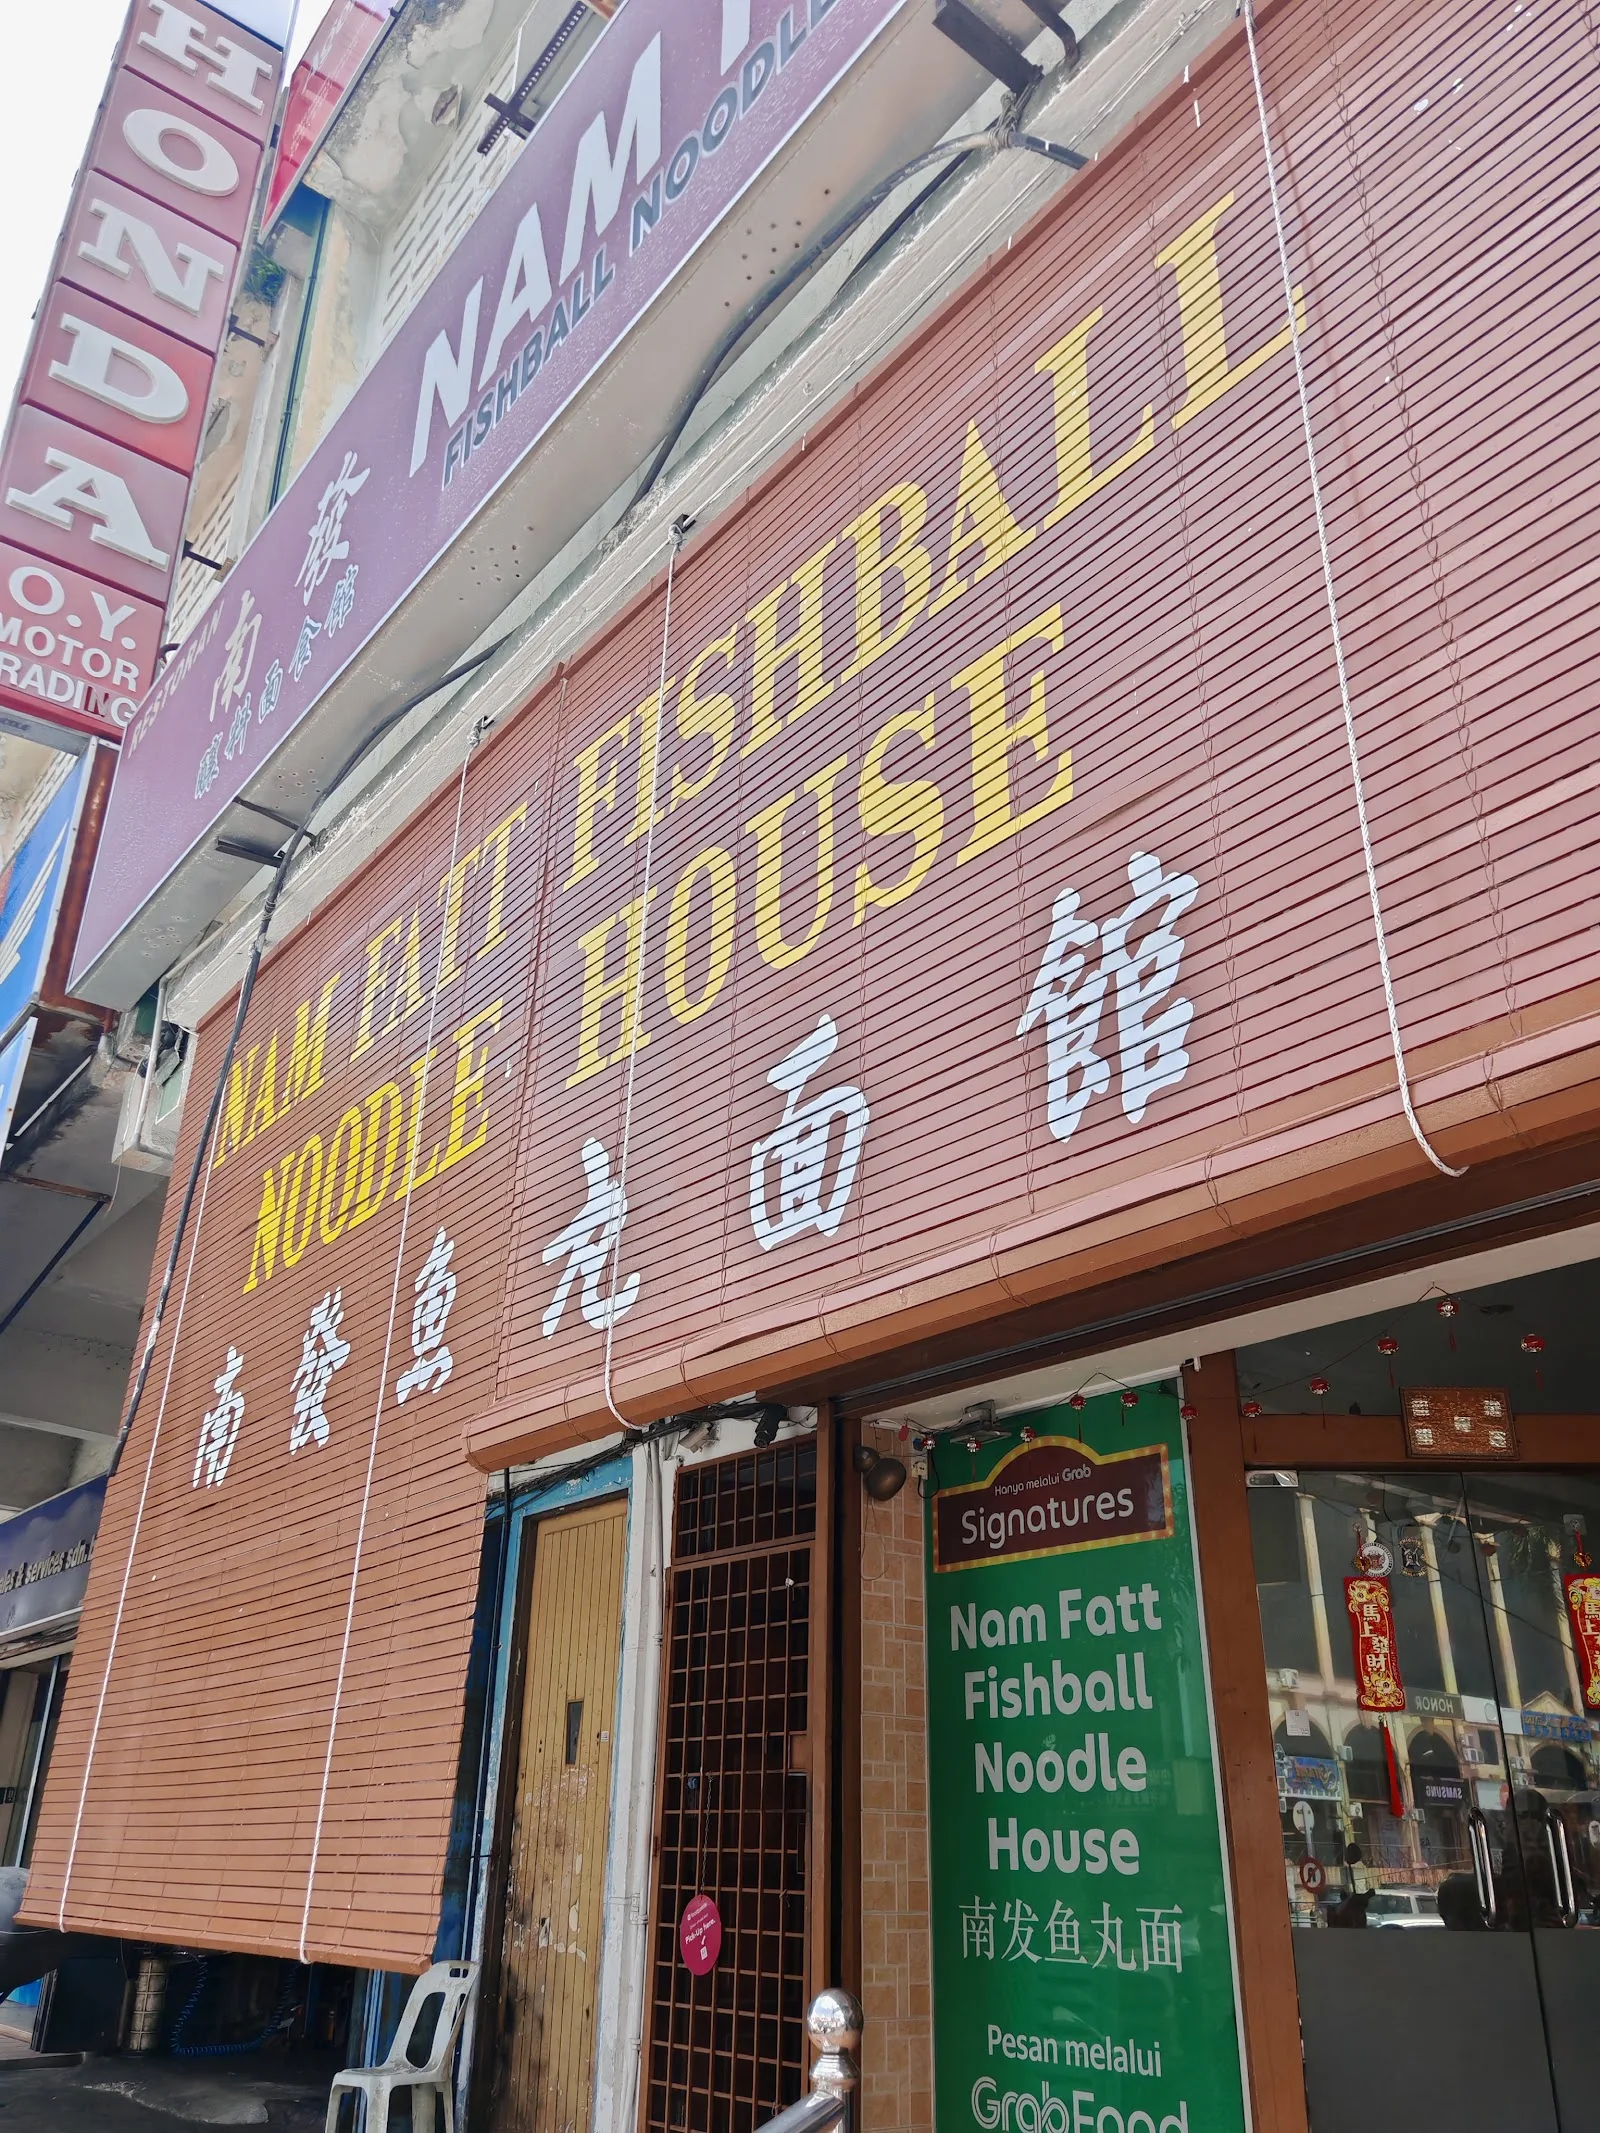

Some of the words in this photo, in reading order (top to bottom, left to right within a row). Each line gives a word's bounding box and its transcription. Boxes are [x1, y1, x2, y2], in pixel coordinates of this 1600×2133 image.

[5, 0, 274, 572] HONDA
[408, 30, 662, 479] NAM
[441, 242, 616, 492] FISHBALL
[8, 566, 137, 650] O.Y.
[127, 599, 225, 760] RESTORAN
[212, 971, 342, 1169] NAM
[348, 802, 530, 1063] FATT
[563, 191, 1306, 892] FISHBALL
[241, 998, 503, 1295] NOODLE
[565, 603, 1074, 1089] HOUSE
[994, 1482, 1025, 1497] Hanya
[1026, 1473, 1060, 1490] melalui
[1062, 1463, 1092, 1482] Grab
[961, 1487, 1135, 1550] Signatures
[25, 1550, 64, 1585] services
[951, 1602, 1047, 1652] Nam
[1058, 1583, 1162, 1640] Fatt
[1359, 1603, 1390, 1672] 馬上發財
[964, 1651, 1153, 1720] Fishball
[974, 1733, 1148, 1794] Noodle
[987, 1817, 1141, 1876] House
[958, 1895, 1184, 1974] 南发鱼丸面
[987, 2023, 1058, 2065] Pesan
[1065, 2036, 1162, 2078] melalui
[971, 2075, 1190, 2133] GrabFood
